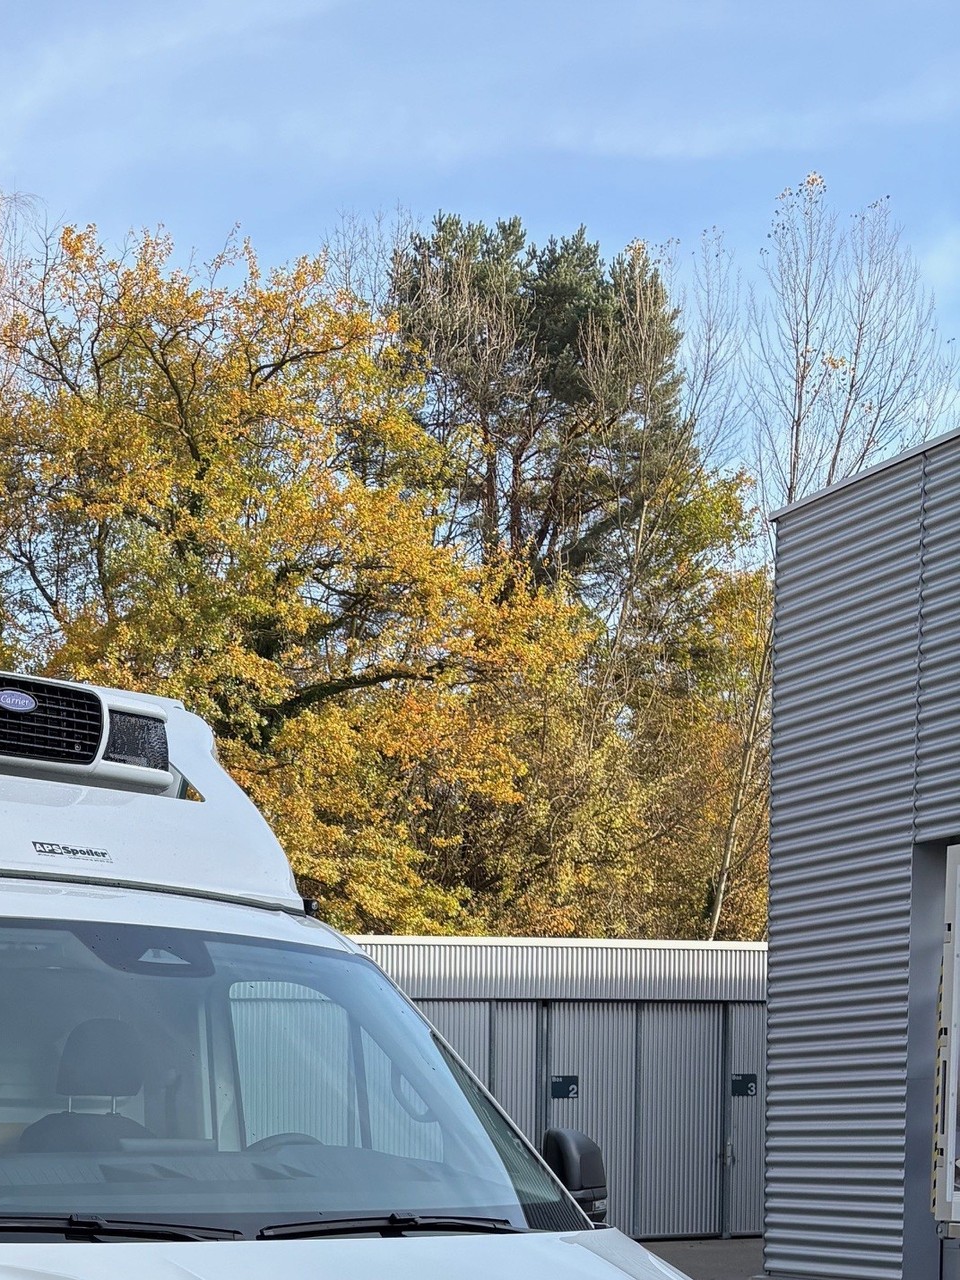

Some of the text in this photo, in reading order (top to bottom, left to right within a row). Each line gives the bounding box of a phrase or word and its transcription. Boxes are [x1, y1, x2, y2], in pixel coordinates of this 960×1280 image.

[0, 694, 30, 706] Carrier
[34, 842, 62, 854] APS
[61, 846, 107, 858] Spoiler
[568, 1084, 578, 1098] 2
[747, 1082, 756, 1096] 3
